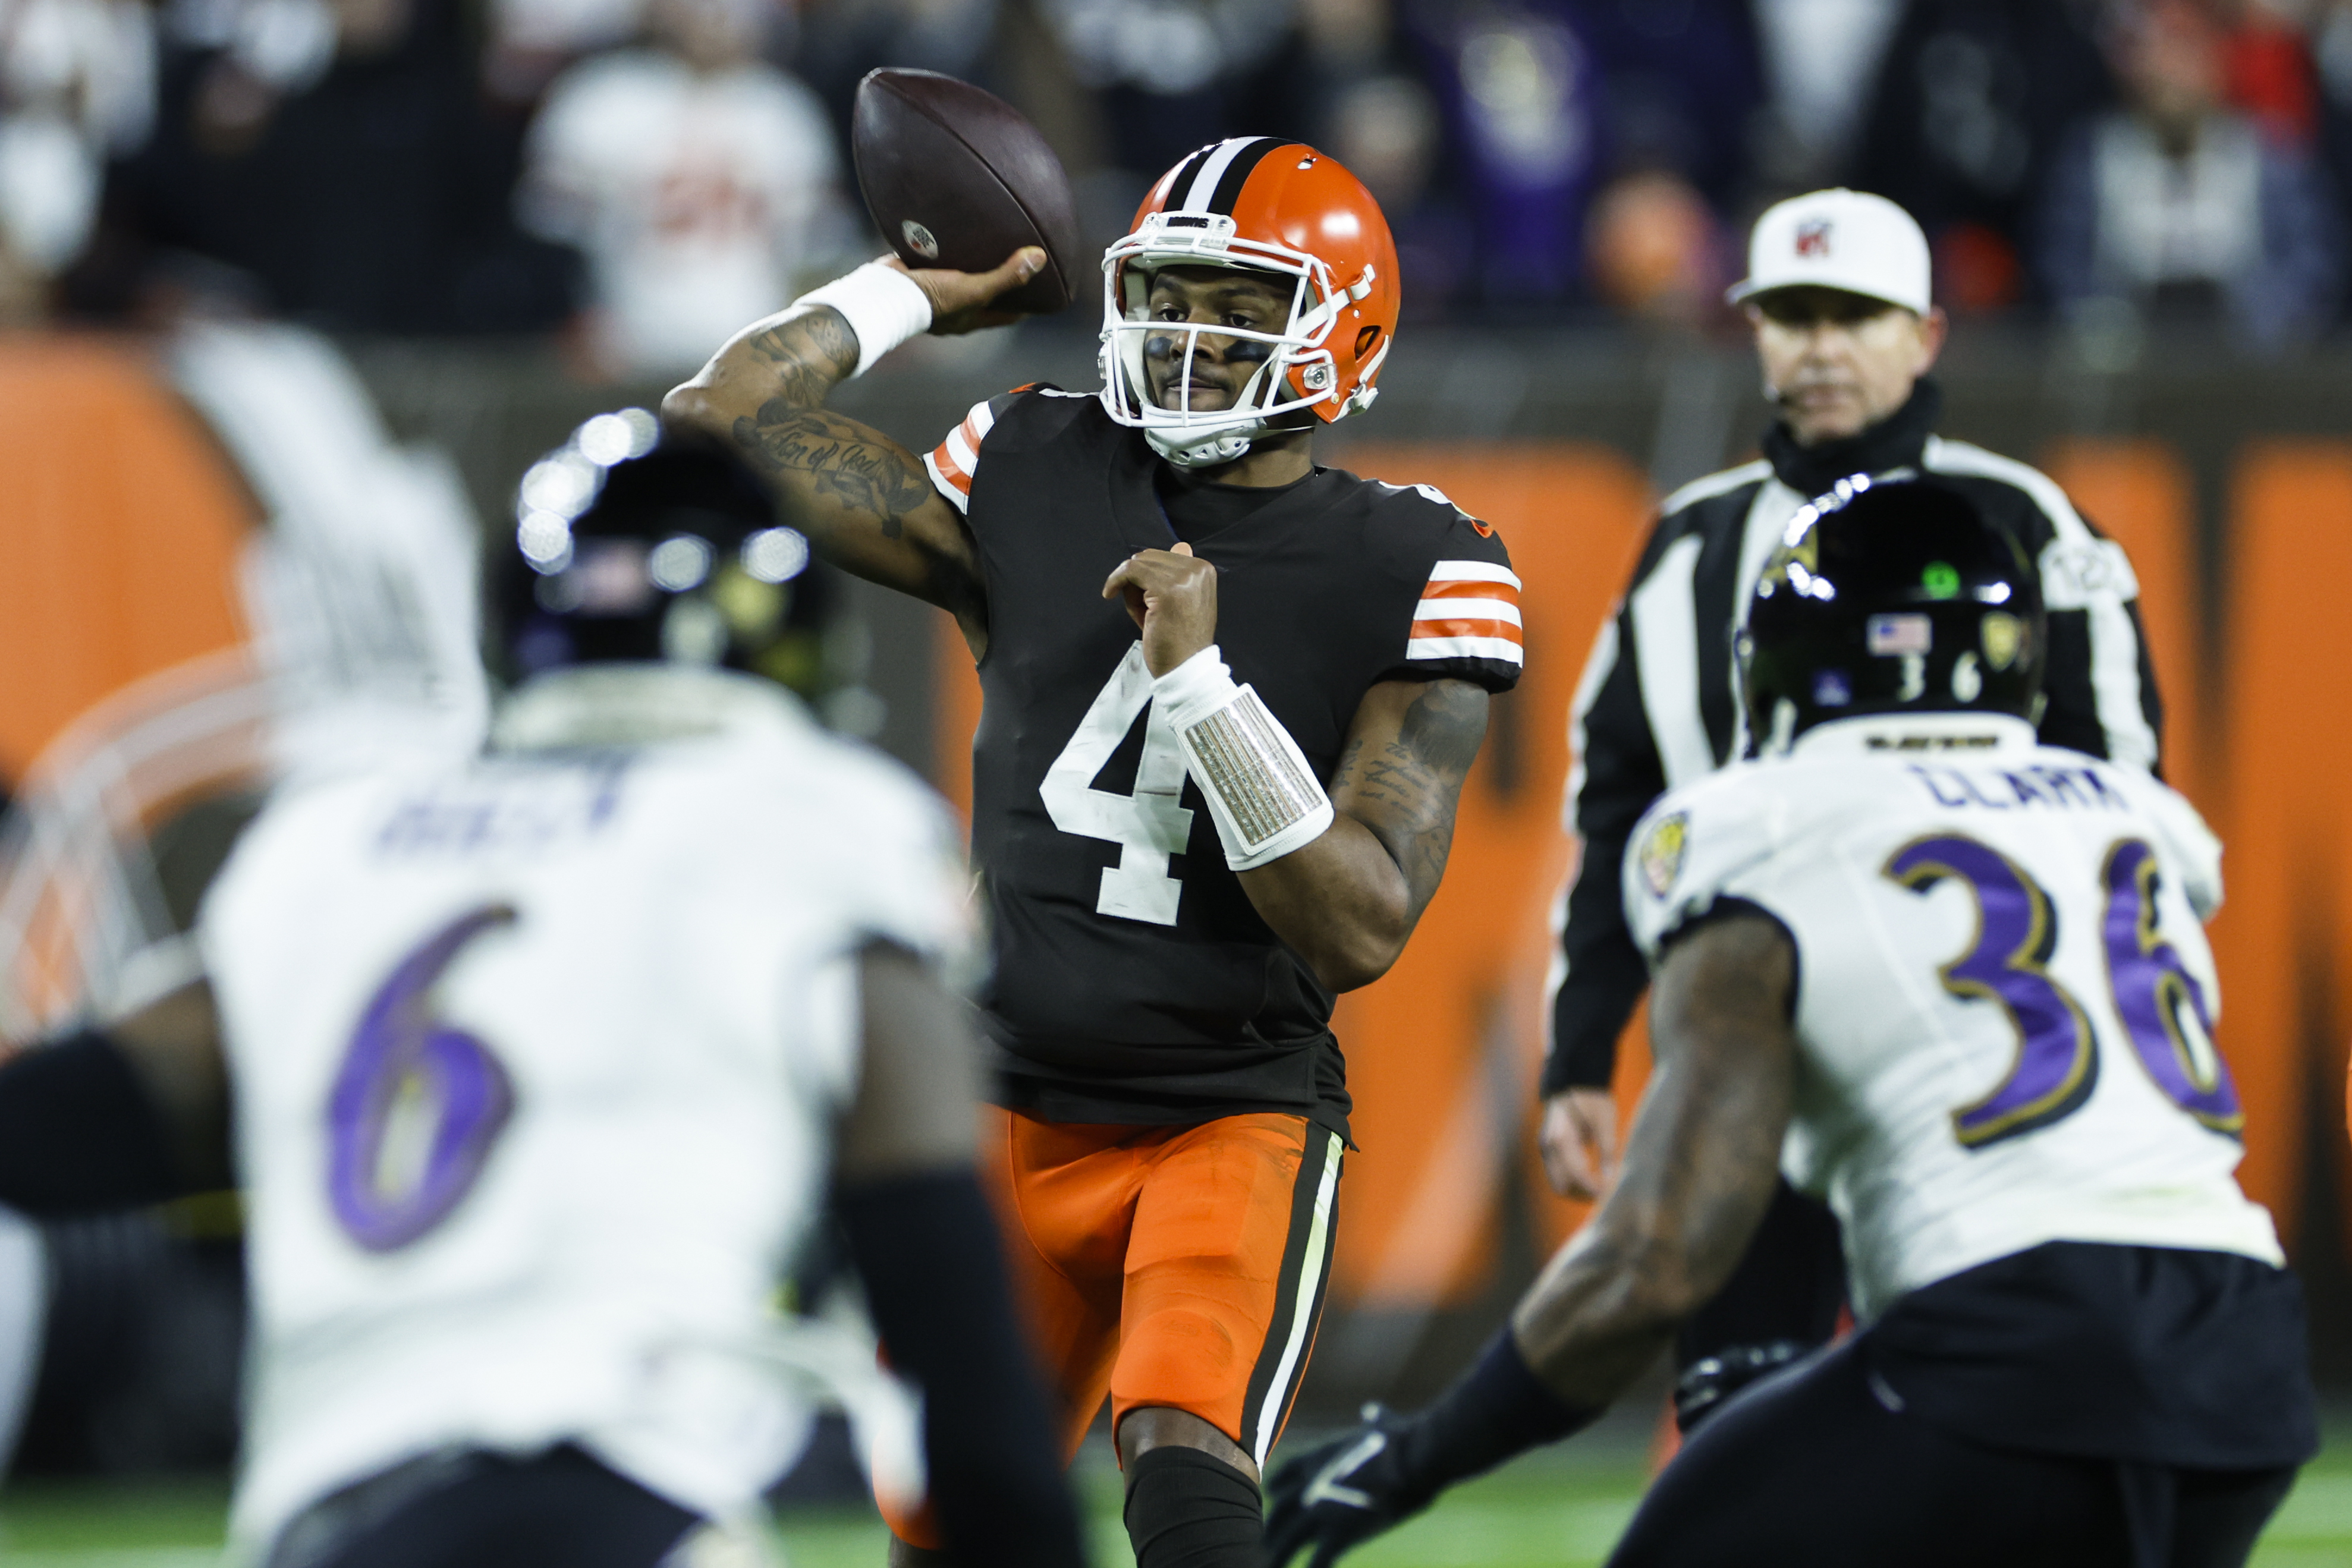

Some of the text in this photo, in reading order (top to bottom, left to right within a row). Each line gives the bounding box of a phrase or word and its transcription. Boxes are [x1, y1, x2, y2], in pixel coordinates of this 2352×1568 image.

[1039, 637, 1194, 927] 4
[325, 901, 518, 1254] 6
[1881, 830, 2246, 1148] 36
